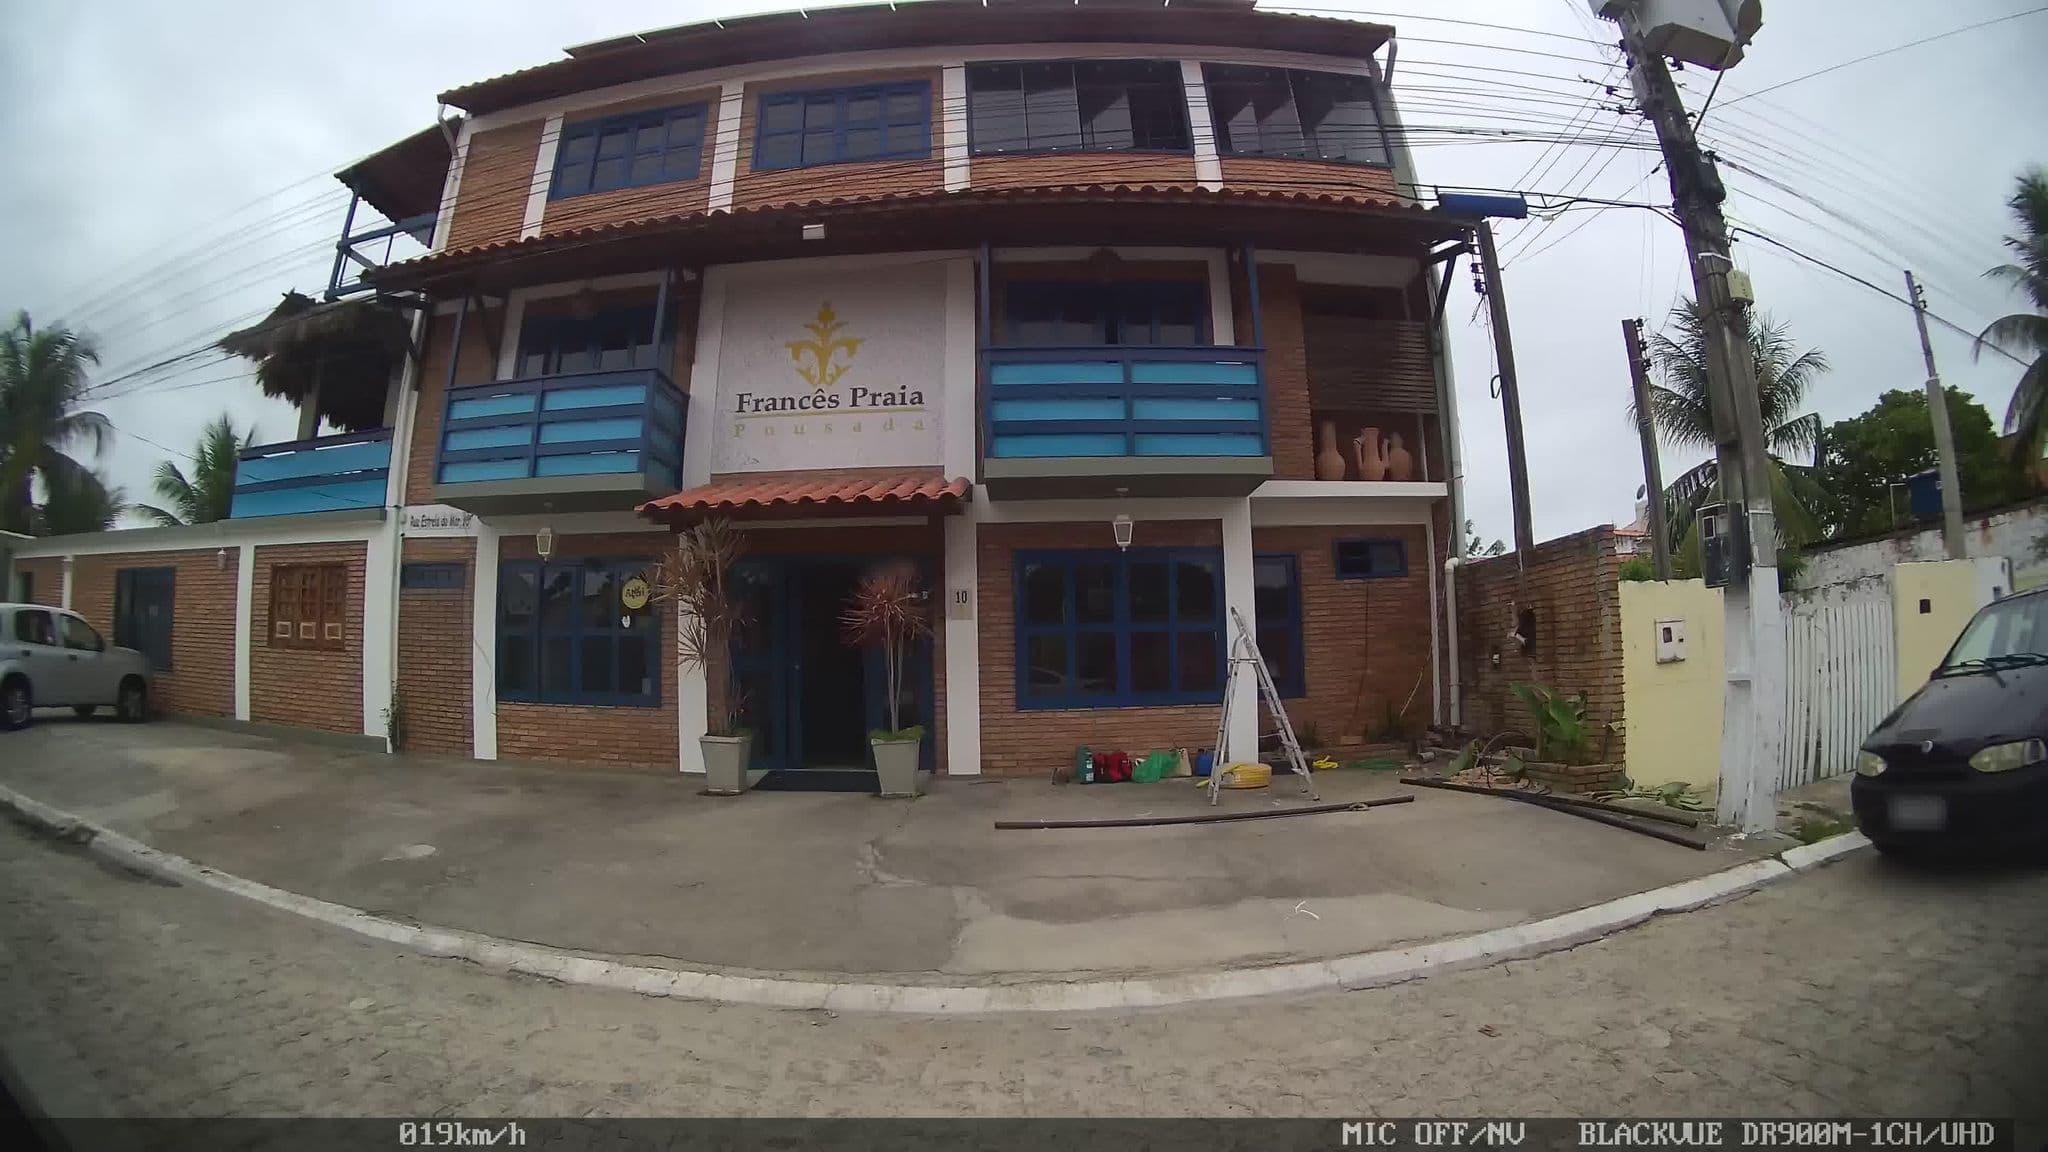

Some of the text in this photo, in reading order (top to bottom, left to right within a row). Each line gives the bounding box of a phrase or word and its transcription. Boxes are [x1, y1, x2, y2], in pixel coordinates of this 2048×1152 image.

[735, 384, 925, 413] Francês Praia
[733, 418, 925, 438] Pousada
[956, 590, 968, 604] 10
